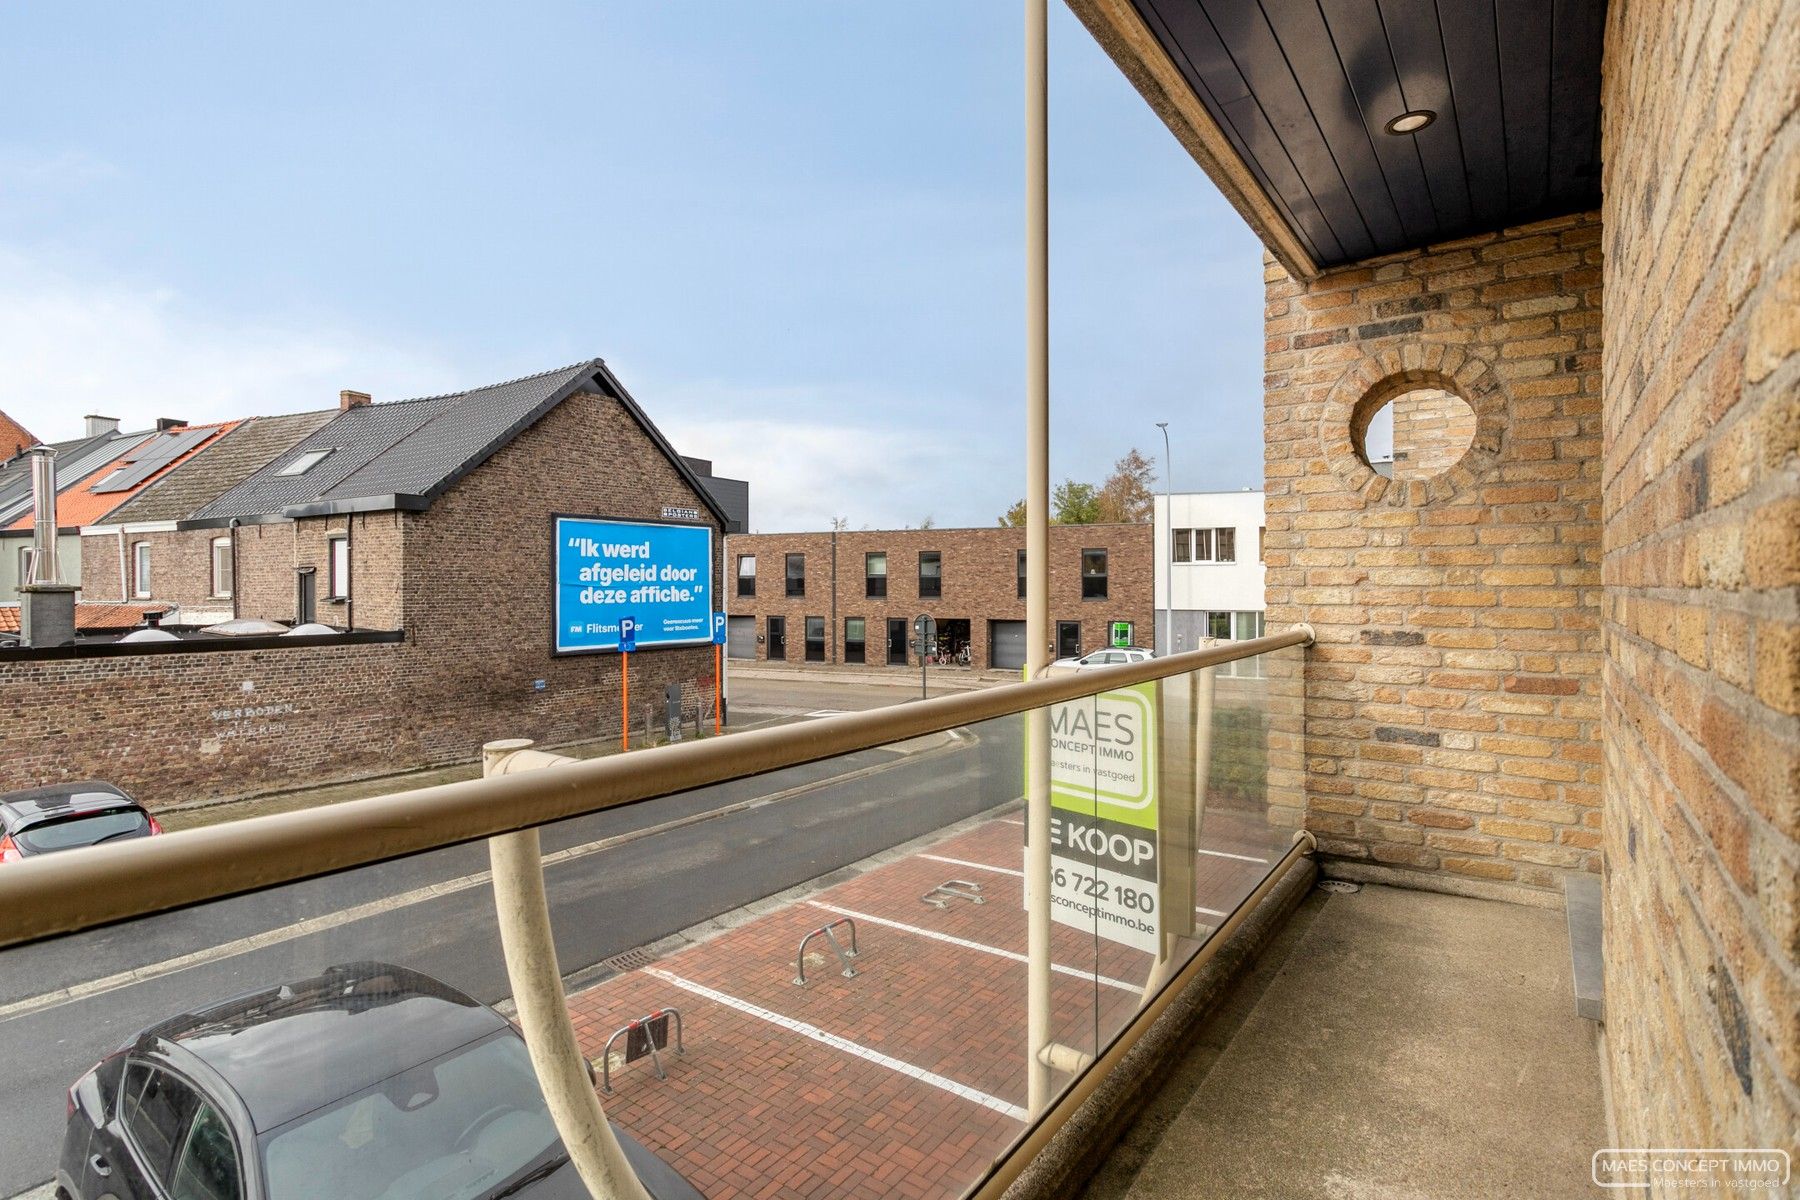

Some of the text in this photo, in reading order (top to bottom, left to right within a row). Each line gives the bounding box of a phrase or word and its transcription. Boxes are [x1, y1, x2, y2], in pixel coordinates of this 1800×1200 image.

[602, 541, 650, 559] werd
[579, 563, 697, 587] afgeleid door
[579, 586, 627, 604] deze
[622, 620, 634, 638] P
[715, 616, 725, 633] P
[1050, 737, 1134, 763] ONCEPT IMMO
[1082, 764, 1091, 774] in
[1068, 823, 1154, 866] KOOP
[1071, 872, 1110, 902] 722
[1114, 885, 1155, 915] 180
[1050, 893, 1155, 936] sconceptimmo.be
